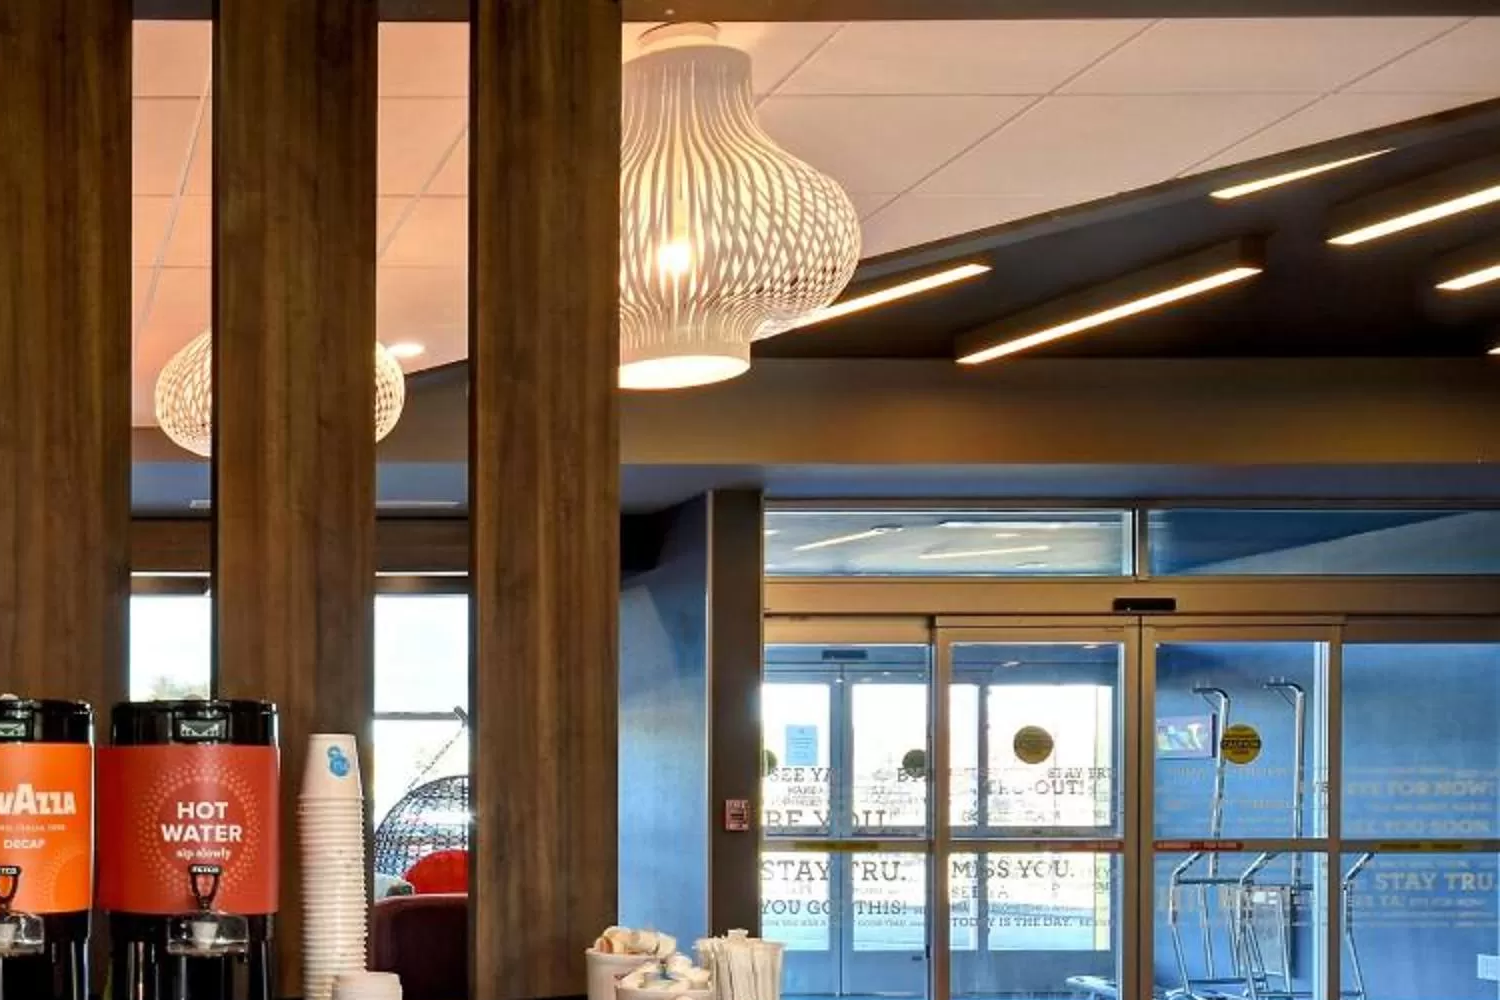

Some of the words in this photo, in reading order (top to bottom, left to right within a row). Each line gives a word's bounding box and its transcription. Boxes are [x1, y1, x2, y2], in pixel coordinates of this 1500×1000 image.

[177, 801, 228, 820] HOT
[161, 823, 243, 843] WATER
[760, 899, 801, 915] YOU
[952, 917, 996, 928] TODY
